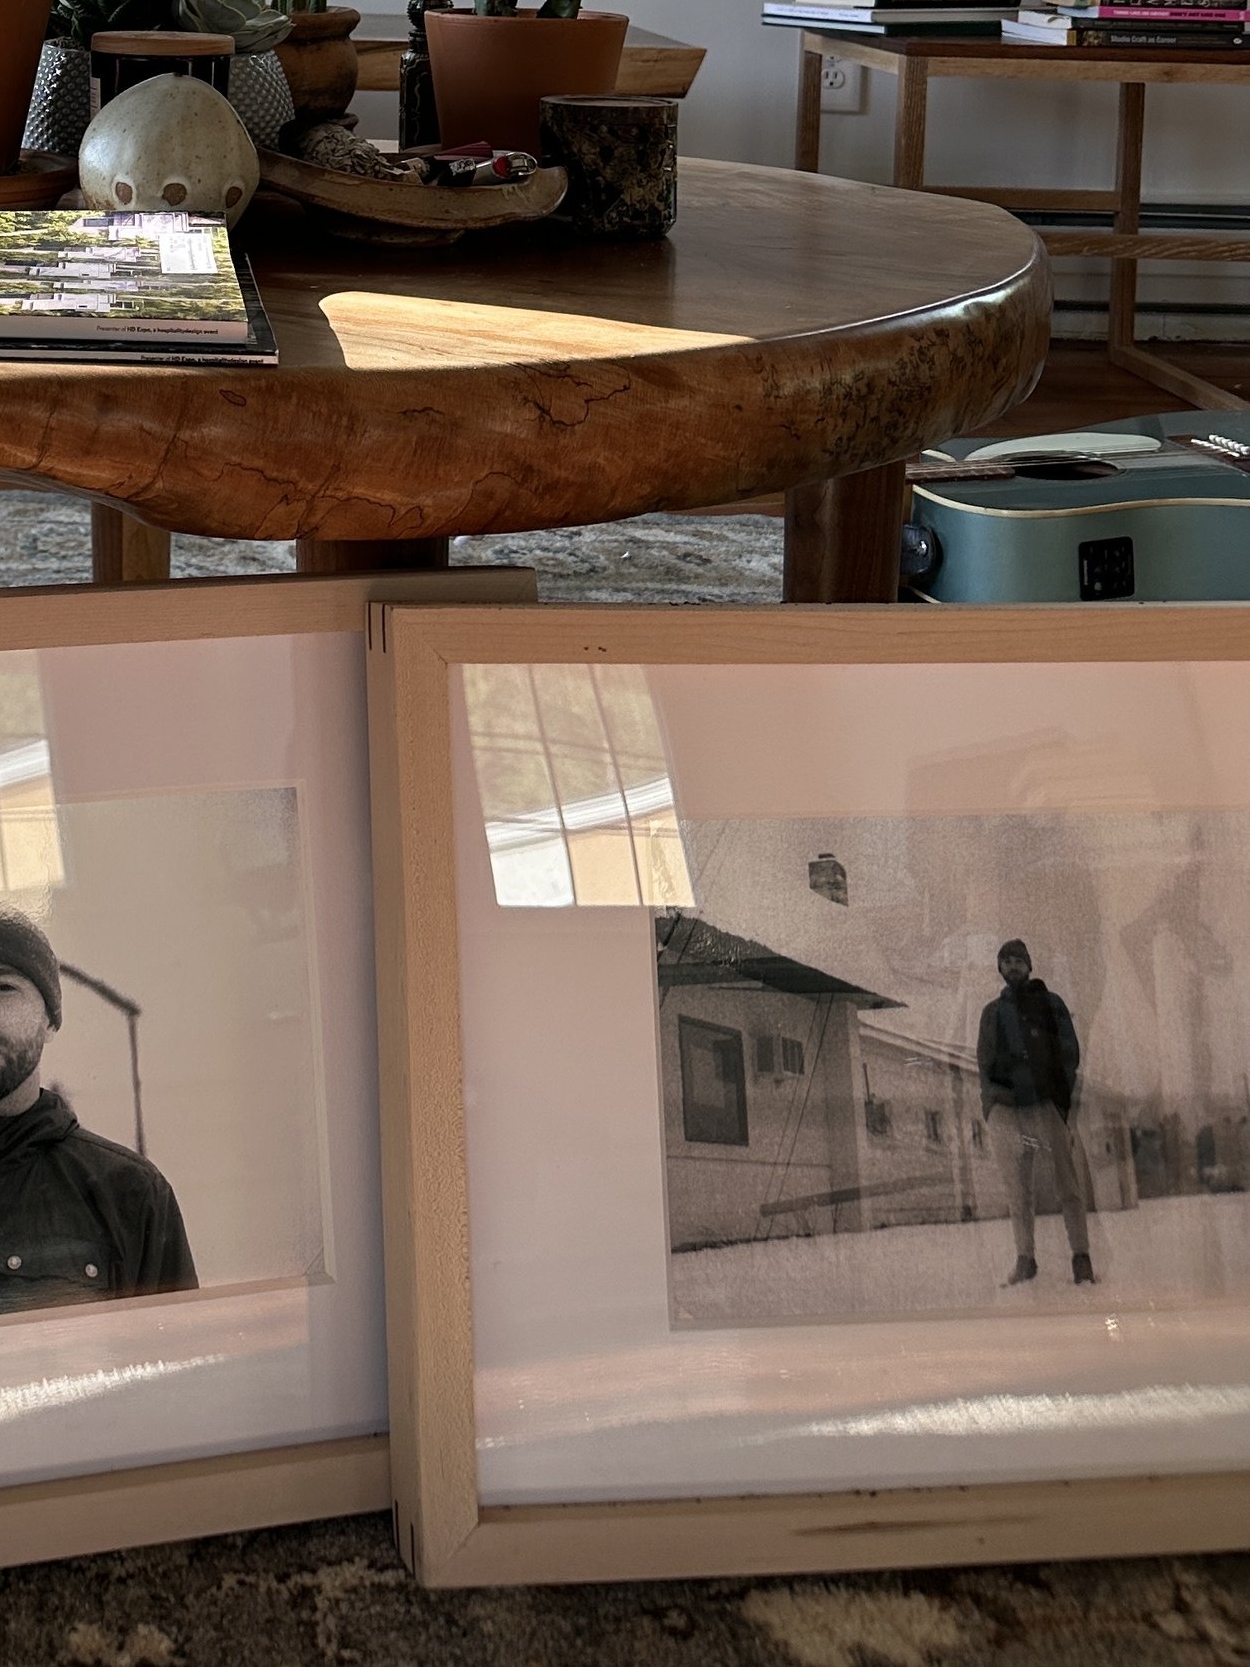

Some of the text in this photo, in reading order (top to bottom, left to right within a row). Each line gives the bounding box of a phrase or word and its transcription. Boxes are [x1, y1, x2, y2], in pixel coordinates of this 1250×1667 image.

[1110, 35, 1131, 43] Studio
[1131, 35, 1147, 43] Craft
[1156, 36, 1177, 44] Career
[96, 325, 121, 333] Presenter
[141, 355, 165, 363] Presenter
